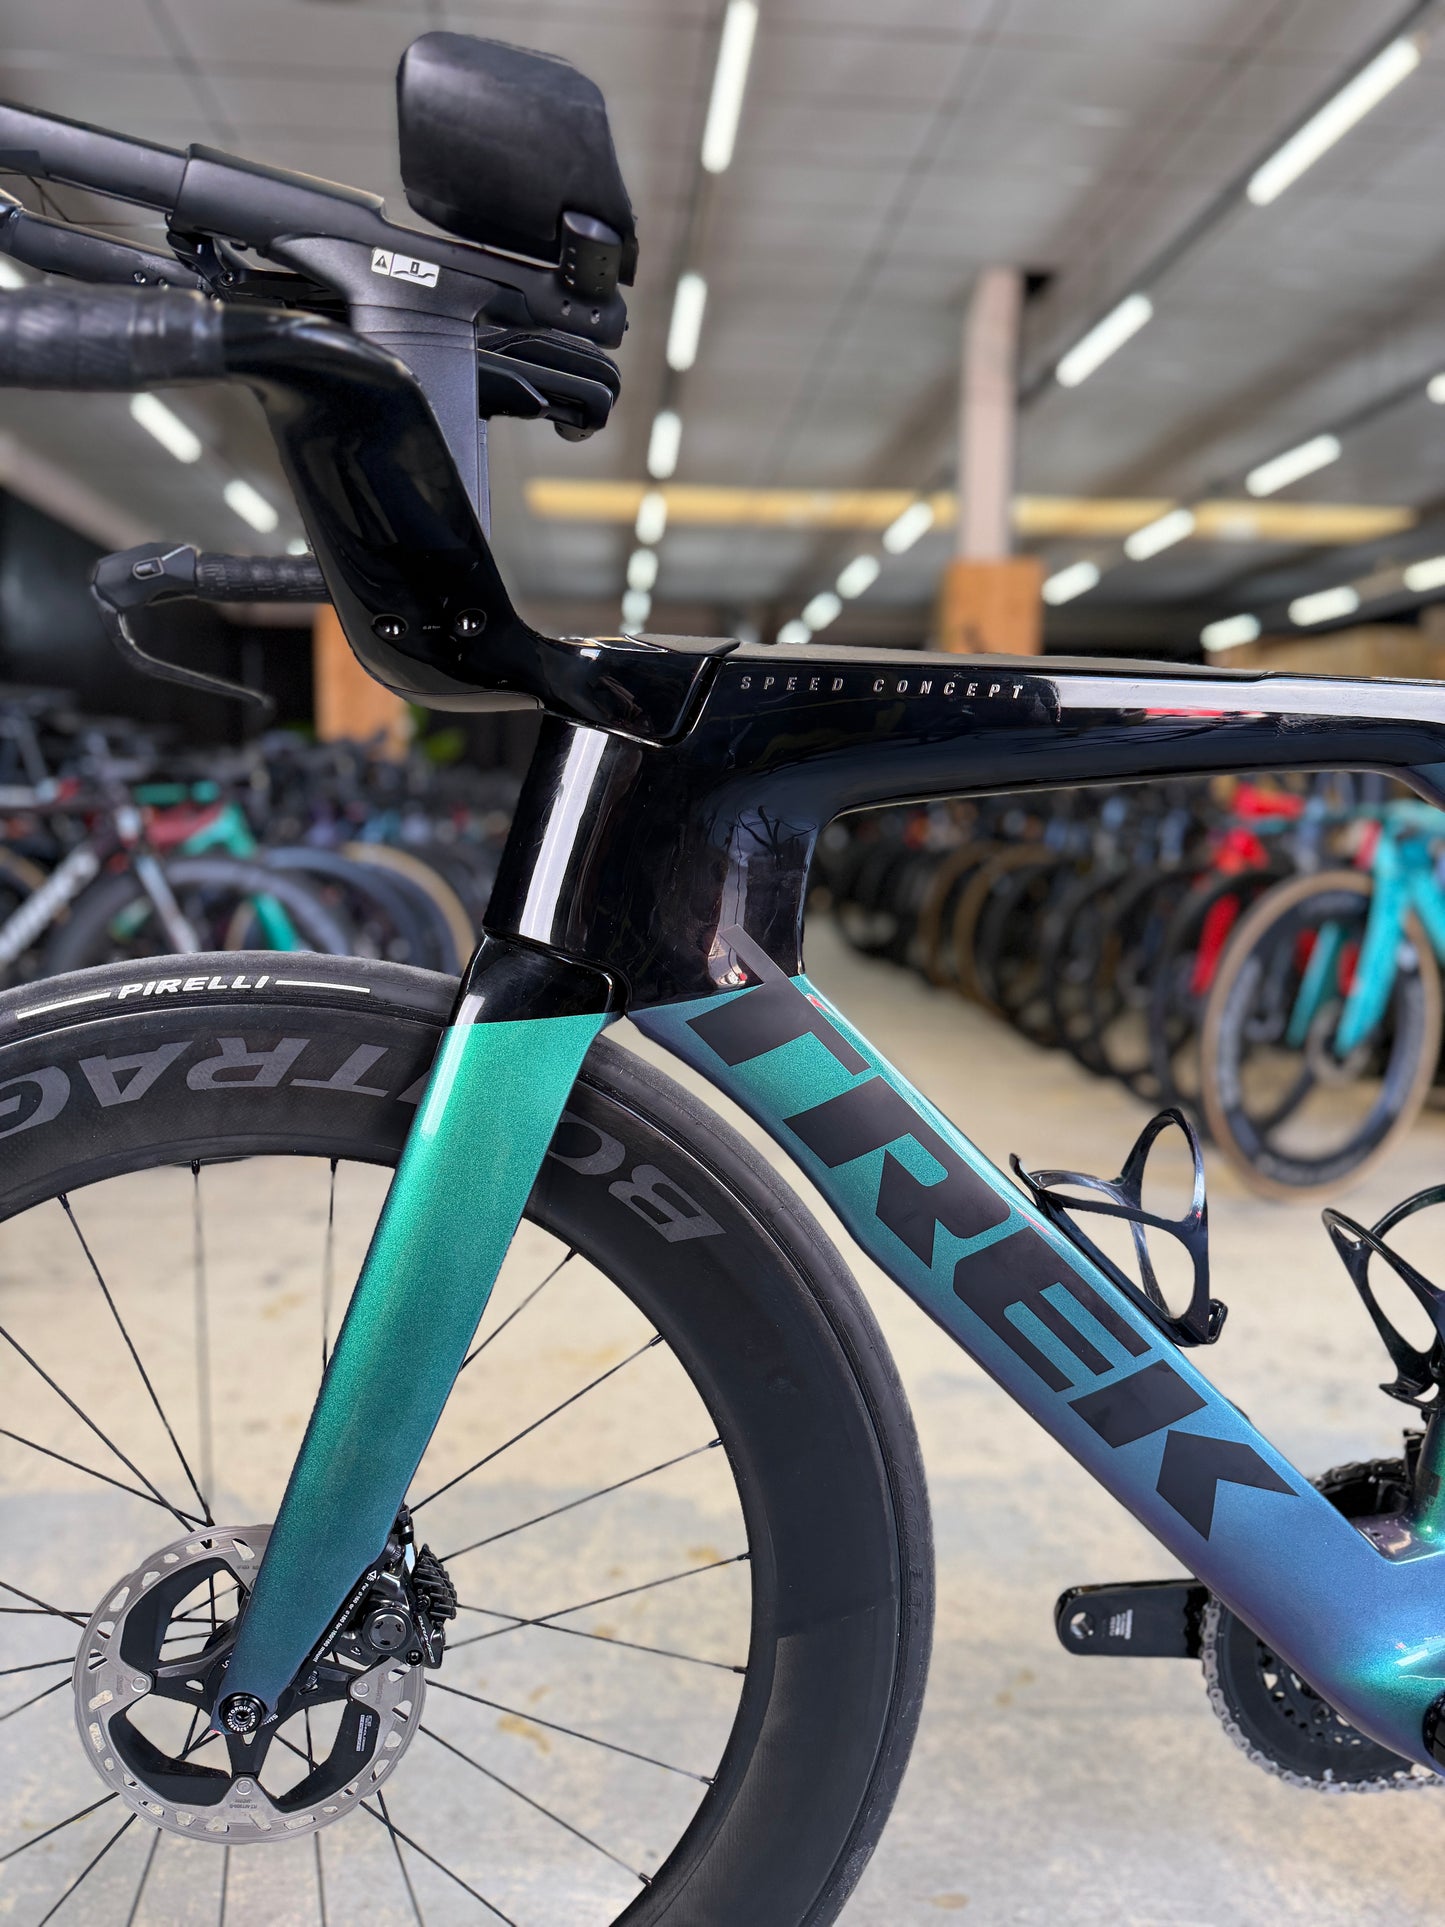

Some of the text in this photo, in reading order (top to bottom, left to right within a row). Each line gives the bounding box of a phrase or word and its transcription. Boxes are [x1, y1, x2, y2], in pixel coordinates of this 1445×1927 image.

[740, 675, 1024, 699] SPEED CONCEPT
[117, 975, 270, 1000] PIRELLI
[686, 924, 1300, 1541] TREK
